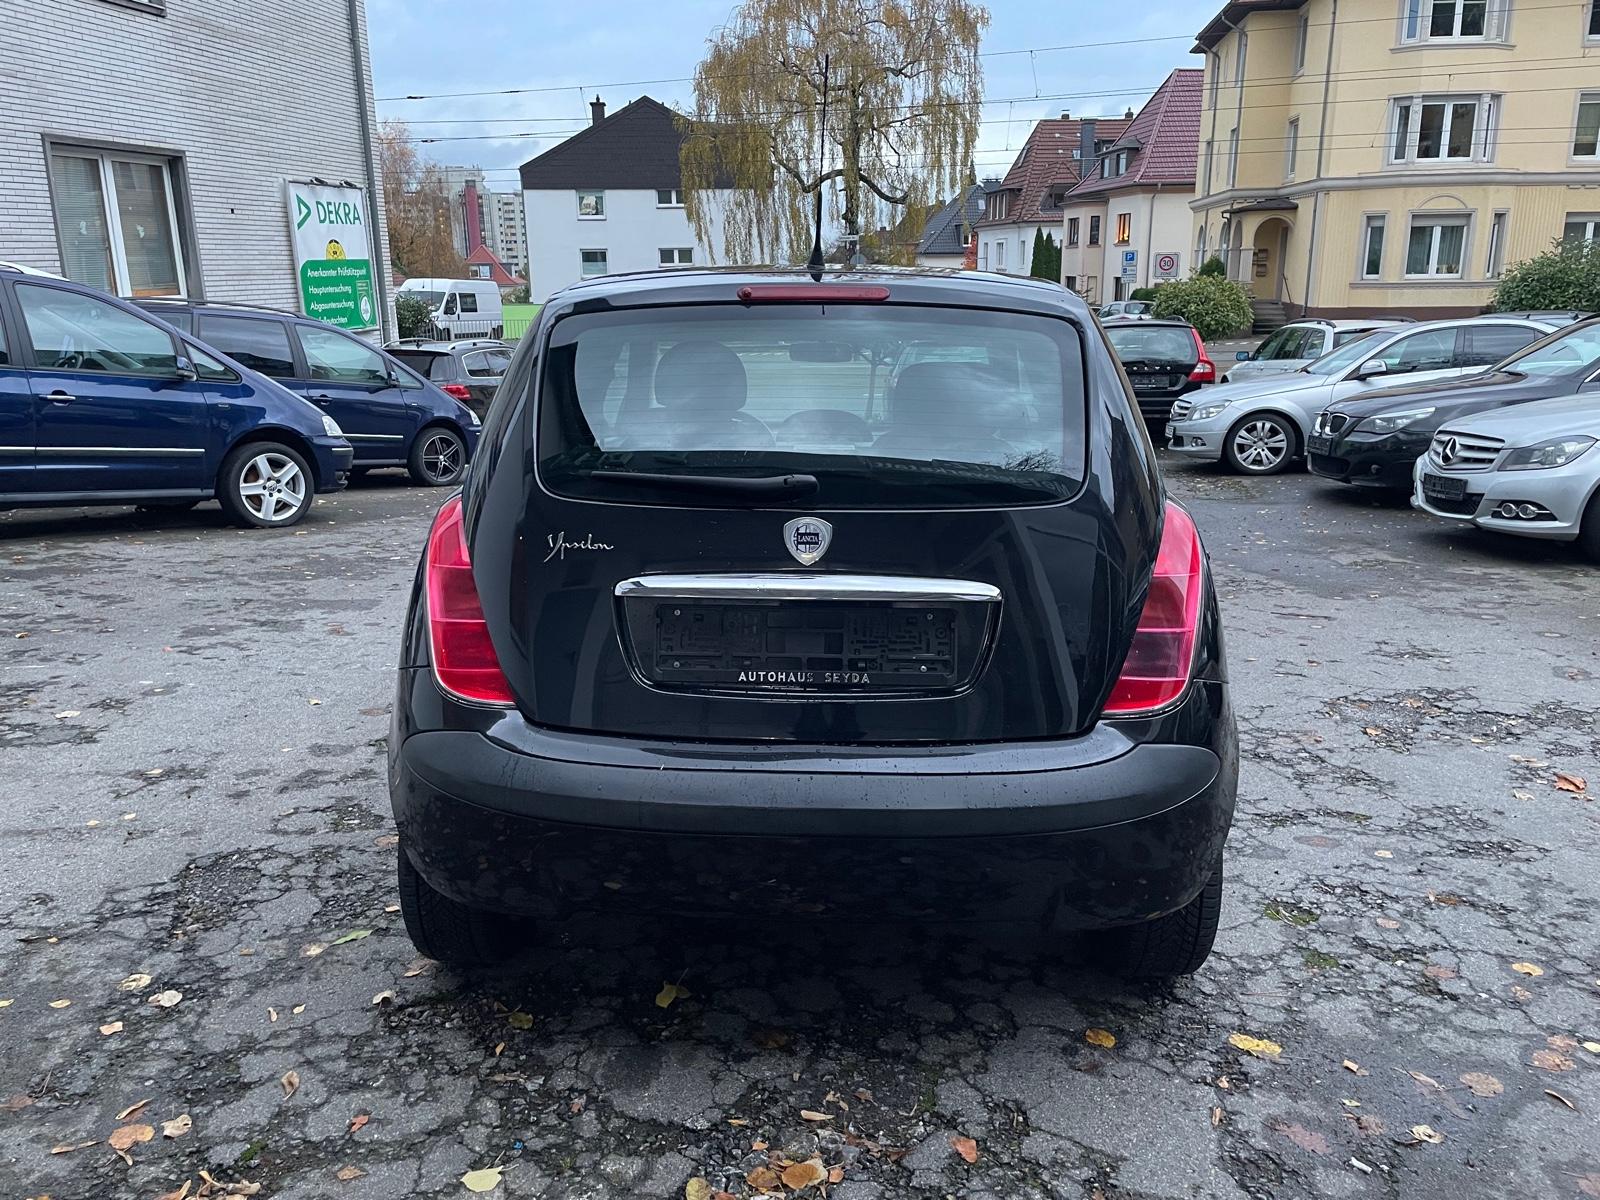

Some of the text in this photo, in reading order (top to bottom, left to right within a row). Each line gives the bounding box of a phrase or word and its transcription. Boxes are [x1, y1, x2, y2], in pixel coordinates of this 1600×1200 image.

[315, 200, 362, 225] DEKRA
[1162, 259, 1172, 267] 30
[308, 283, 352, 296] Hauptuntersuchung
[310, 299, 355, 313] Abgasuntersuchung
[318, 315, 348, 326] llgutachten
[798, 535, 819, 543] LANCIA
[543, 531, 615, 563] Ypsilon
[738, 671, 871, 684] AUTOHAUS SEYDA
